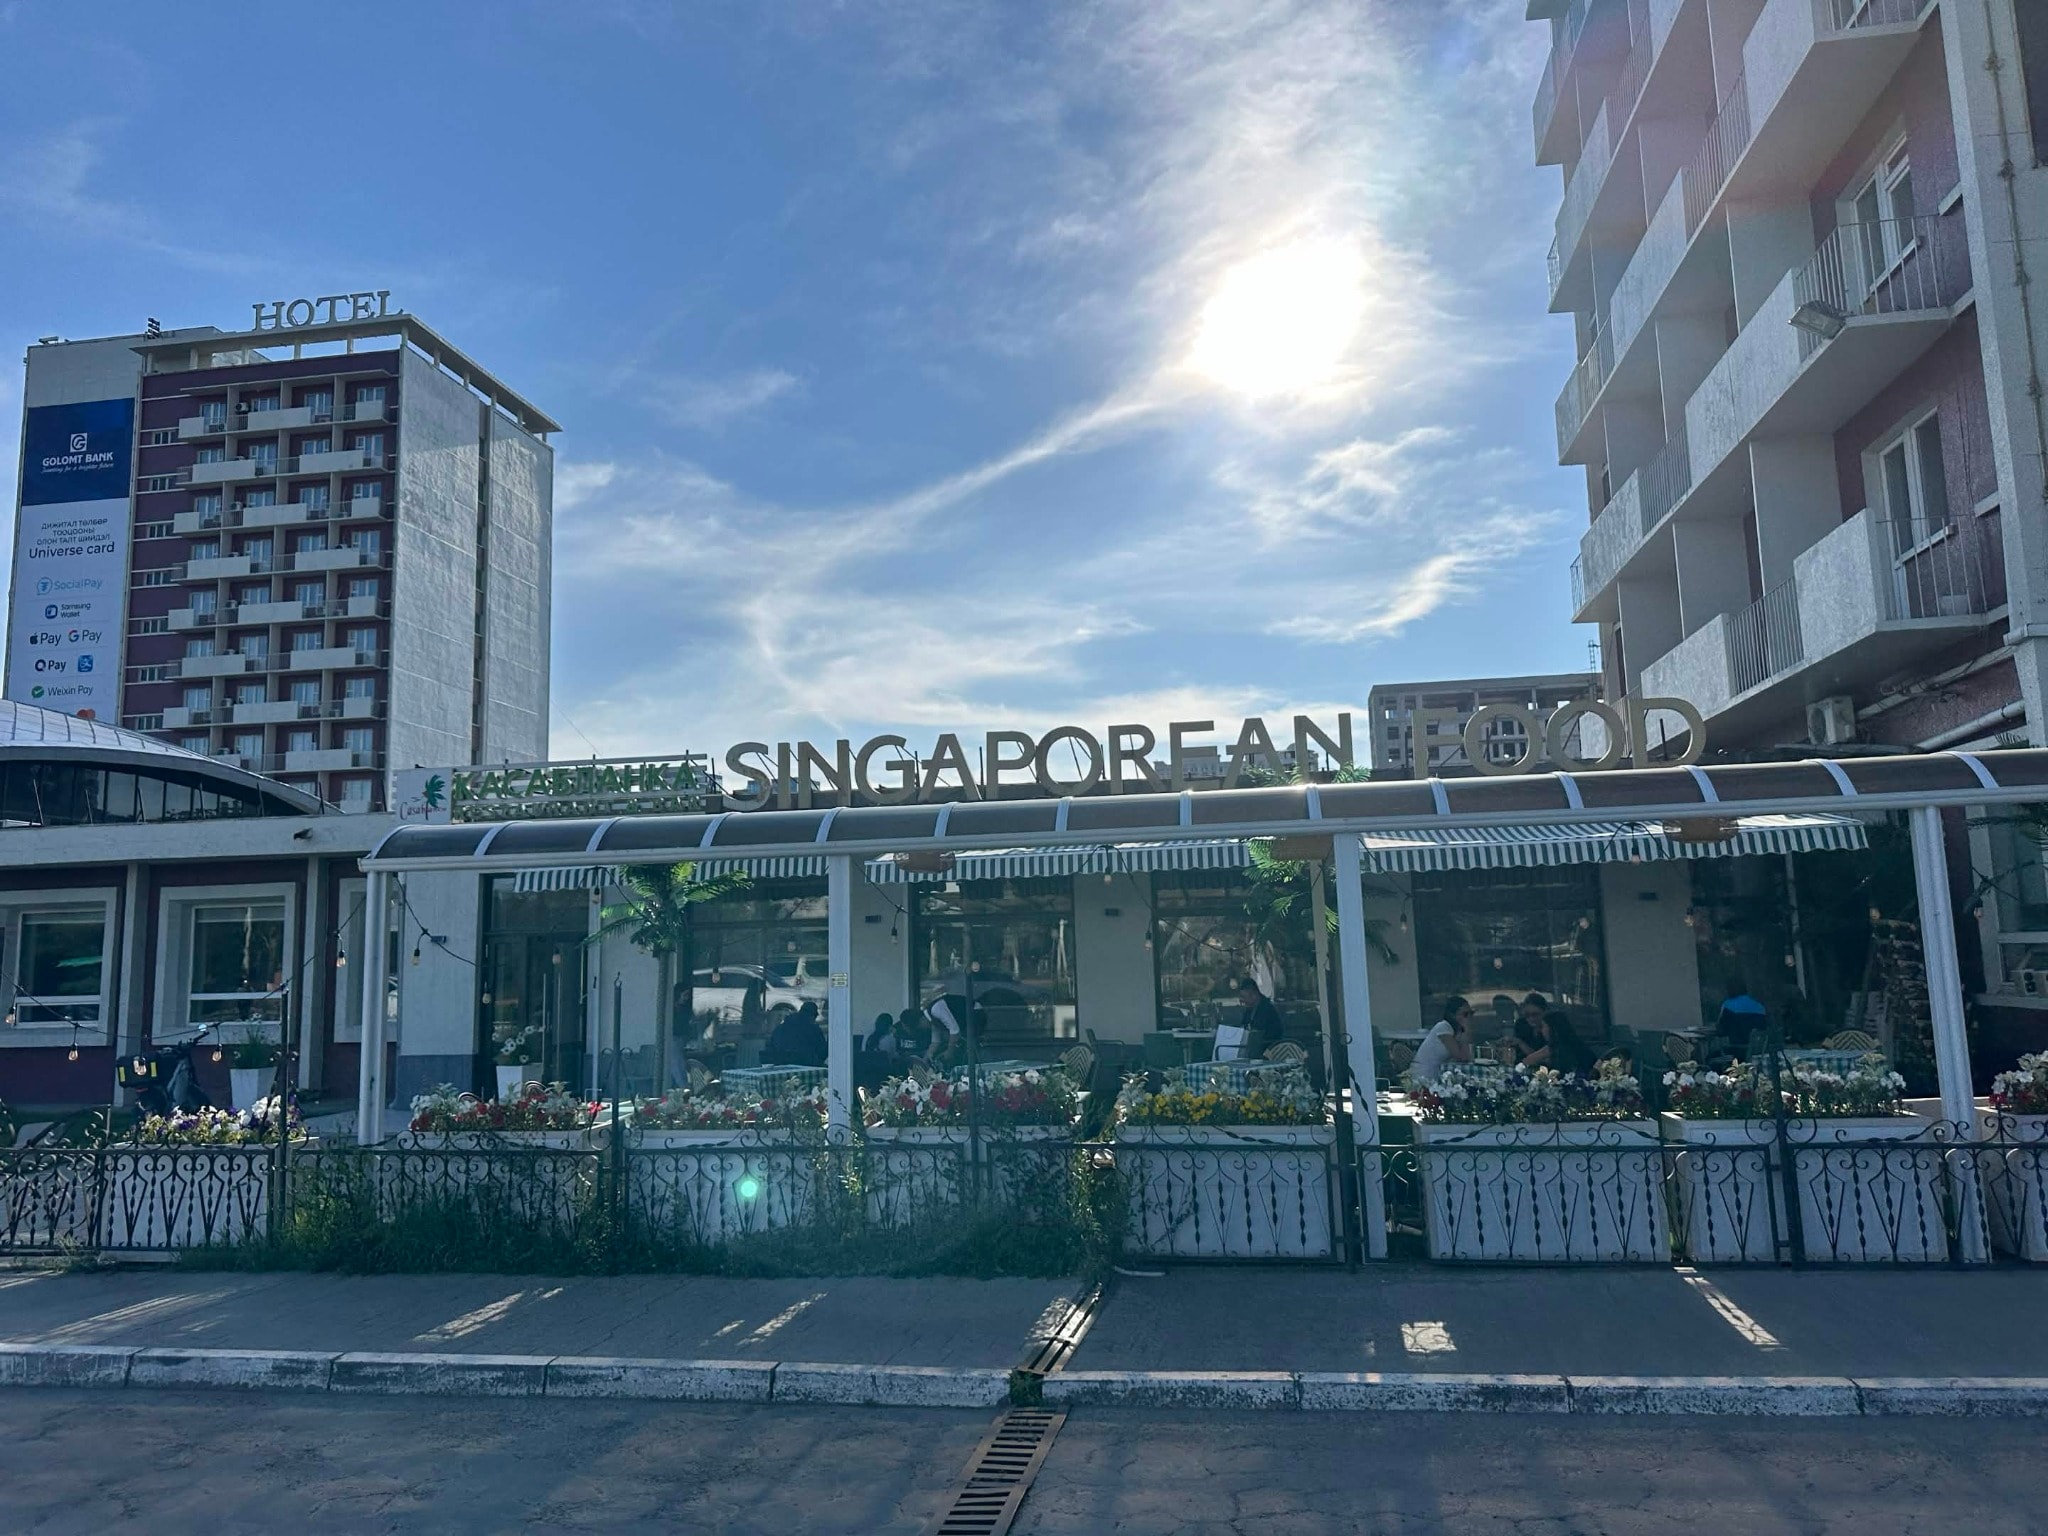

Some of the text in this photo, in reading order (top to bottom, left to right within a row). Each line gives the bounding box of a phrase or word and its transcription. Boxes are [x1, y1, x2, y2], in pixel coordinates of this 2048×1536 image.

[252, 290, 403, 332] HOTEL
[42, 451, 113, 467] GOLOMT BANK
[53, 527, 95, 537] ТООЦООНЫ
[59, 536, 76, 544] ТАЛТ
[29, 541, 115, 559] Universe card
[54, 578, 102, 590] SocialPay
[61, 602, 91, 611] Samsung
[60, 611, 80, 619] Wallet
[40, 632, 61, 646] Pay
[82, 629, 102, 644] Pay
[47, 684, 94, 697] Weixin Pay
[723, 697, 1707, 812] SINGAPOREAN FOOD
[453, 762, 700, 801] КАСАБЛАНКА
